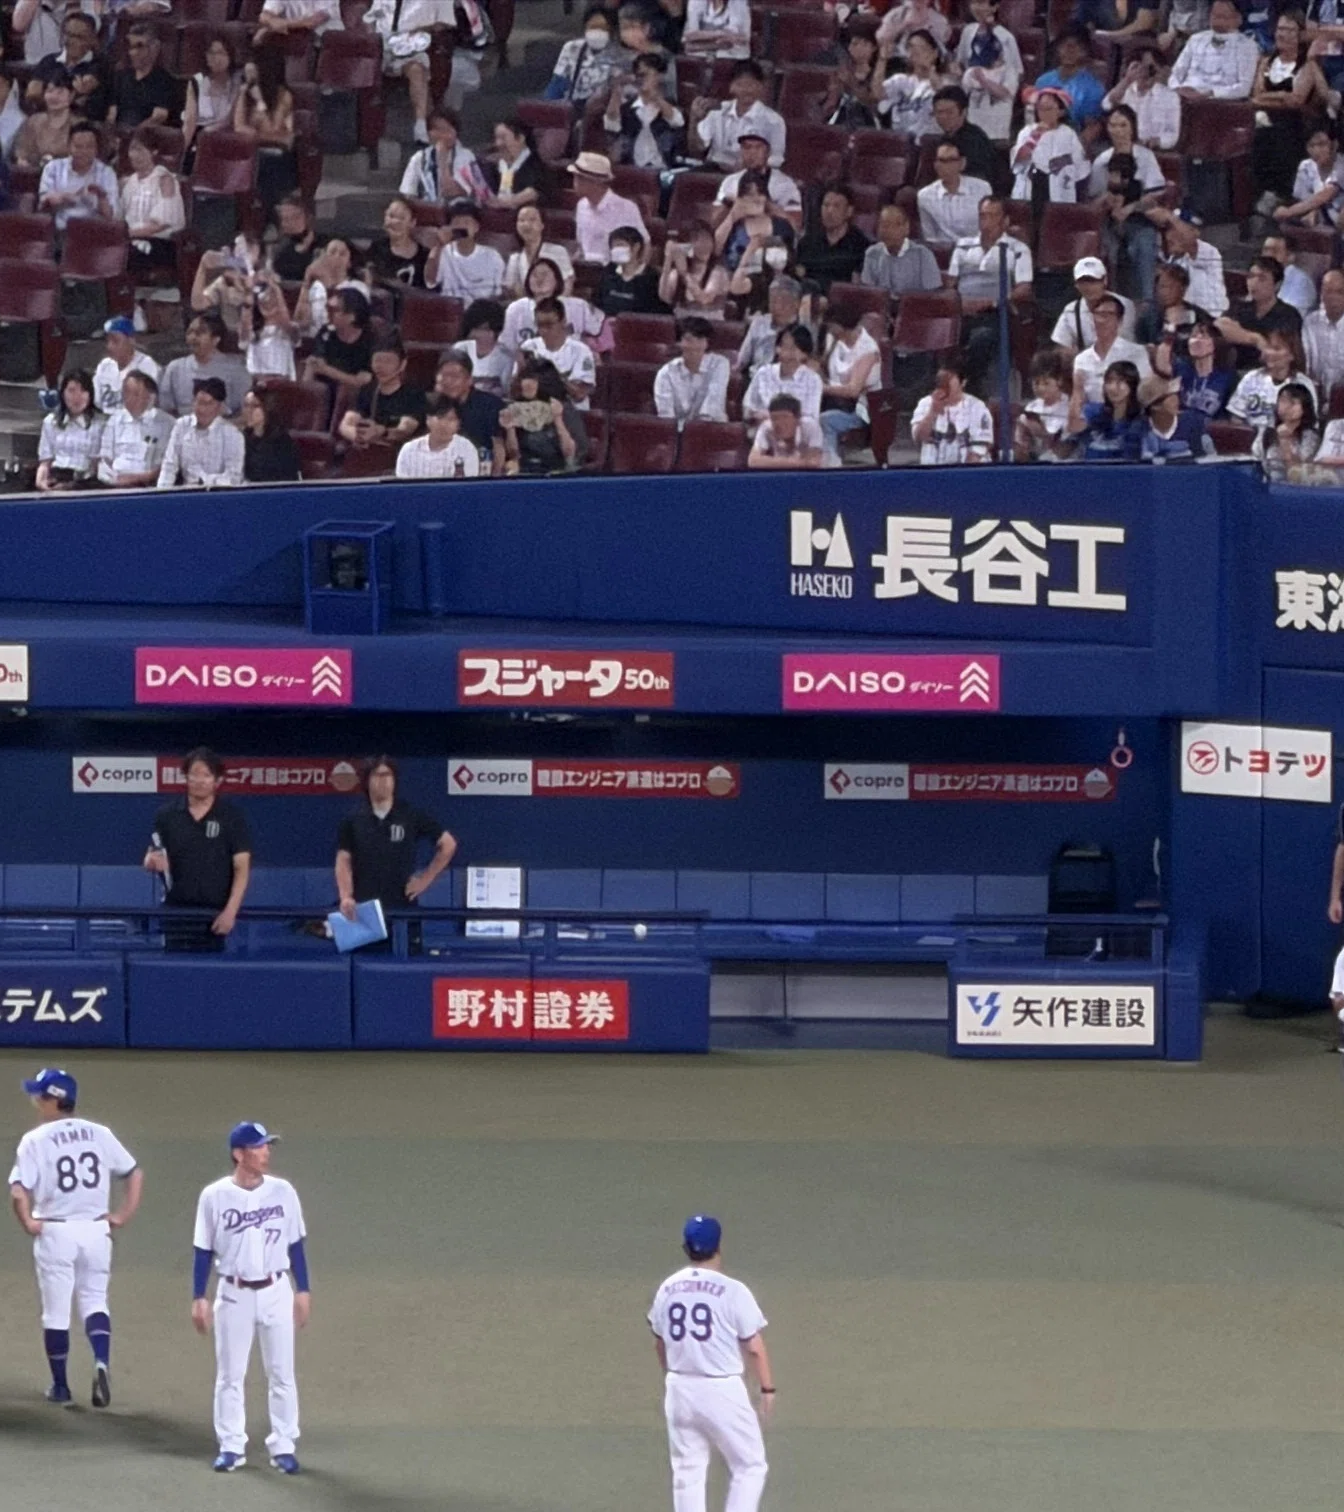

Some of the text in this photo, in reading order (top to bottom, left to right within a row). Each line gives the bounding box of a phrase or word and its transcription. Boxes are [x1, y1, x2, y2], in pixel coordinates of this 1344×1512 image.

[871, 514, 1127, 611] 長谷工
[790, 572, 853, 599] HASEKO
[146, 665, 257, 687] DAISO
[464, 658, 669, 697] スジャータ 50th
[793, 672, 905, 693] DAISO
[101, 766, 152, 785] copro
[1224, 746, 1327, 778] トヨテツ
[476, 770, 528, 785] copro
[854, 775, 905, 789] copro
[447, 988, 615, 1030] 野村證券
[1012, 996, 1146, 1029] 矢作建設
[56, 1151, 101, 1193] 83
[222, 1205, 285, 1234] Dragons
[668, 1302, 713, 1341] 89
